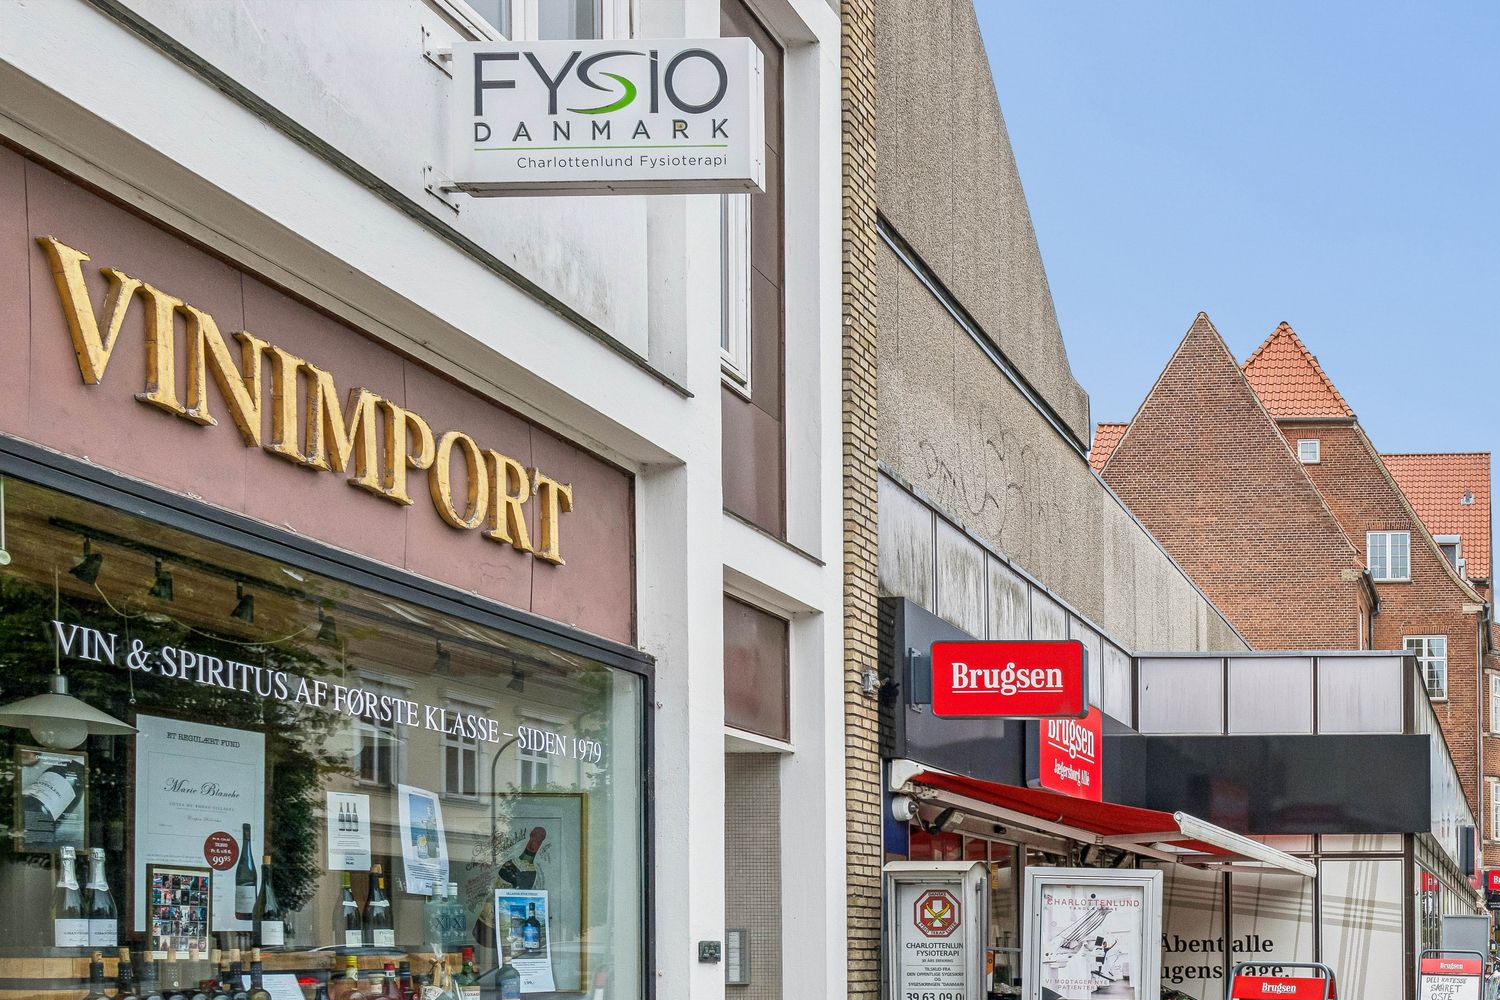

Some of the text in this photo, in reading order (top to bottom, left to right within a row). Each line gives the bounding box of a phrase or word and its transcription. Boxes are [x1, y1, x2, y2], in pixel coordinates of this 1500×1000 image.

[474, 48, 728, 116] FYSIO
[474, 118, 730, 142] DANMARK
[516, 153, 728, 169] Charlottenlund Fysioterapi
[35, 235, 573, 566] VINIMPORT
[951, 662, 1063, 695] Brugsen
[52, 620, 117, 665] VIN
[126, 639, 152, 672] &
[161, 646, 288, 700] SPIRITUS
[295, 677, 328, 707] AF
[334, 684, 420, 727] FØRSTE
[425, 704, 500, 743] KLASSE
[517, 725, 567, 757] SIDEN
[572, 737, 602, 763] 1979
[1048, 719, 1095, 759] Brugsen
[164, 777, 240, 798] Marie Blanche
[1047, 897, 1140, 908] CHARLOTTENLUND
[1161, 932, 1274, 952] Åbent alle
[1440, 962, 1463, 970] Brugsen
[1262, 982, 1296, 994] Brugsen
[1431, 992, 1454, 1000] OSTE
